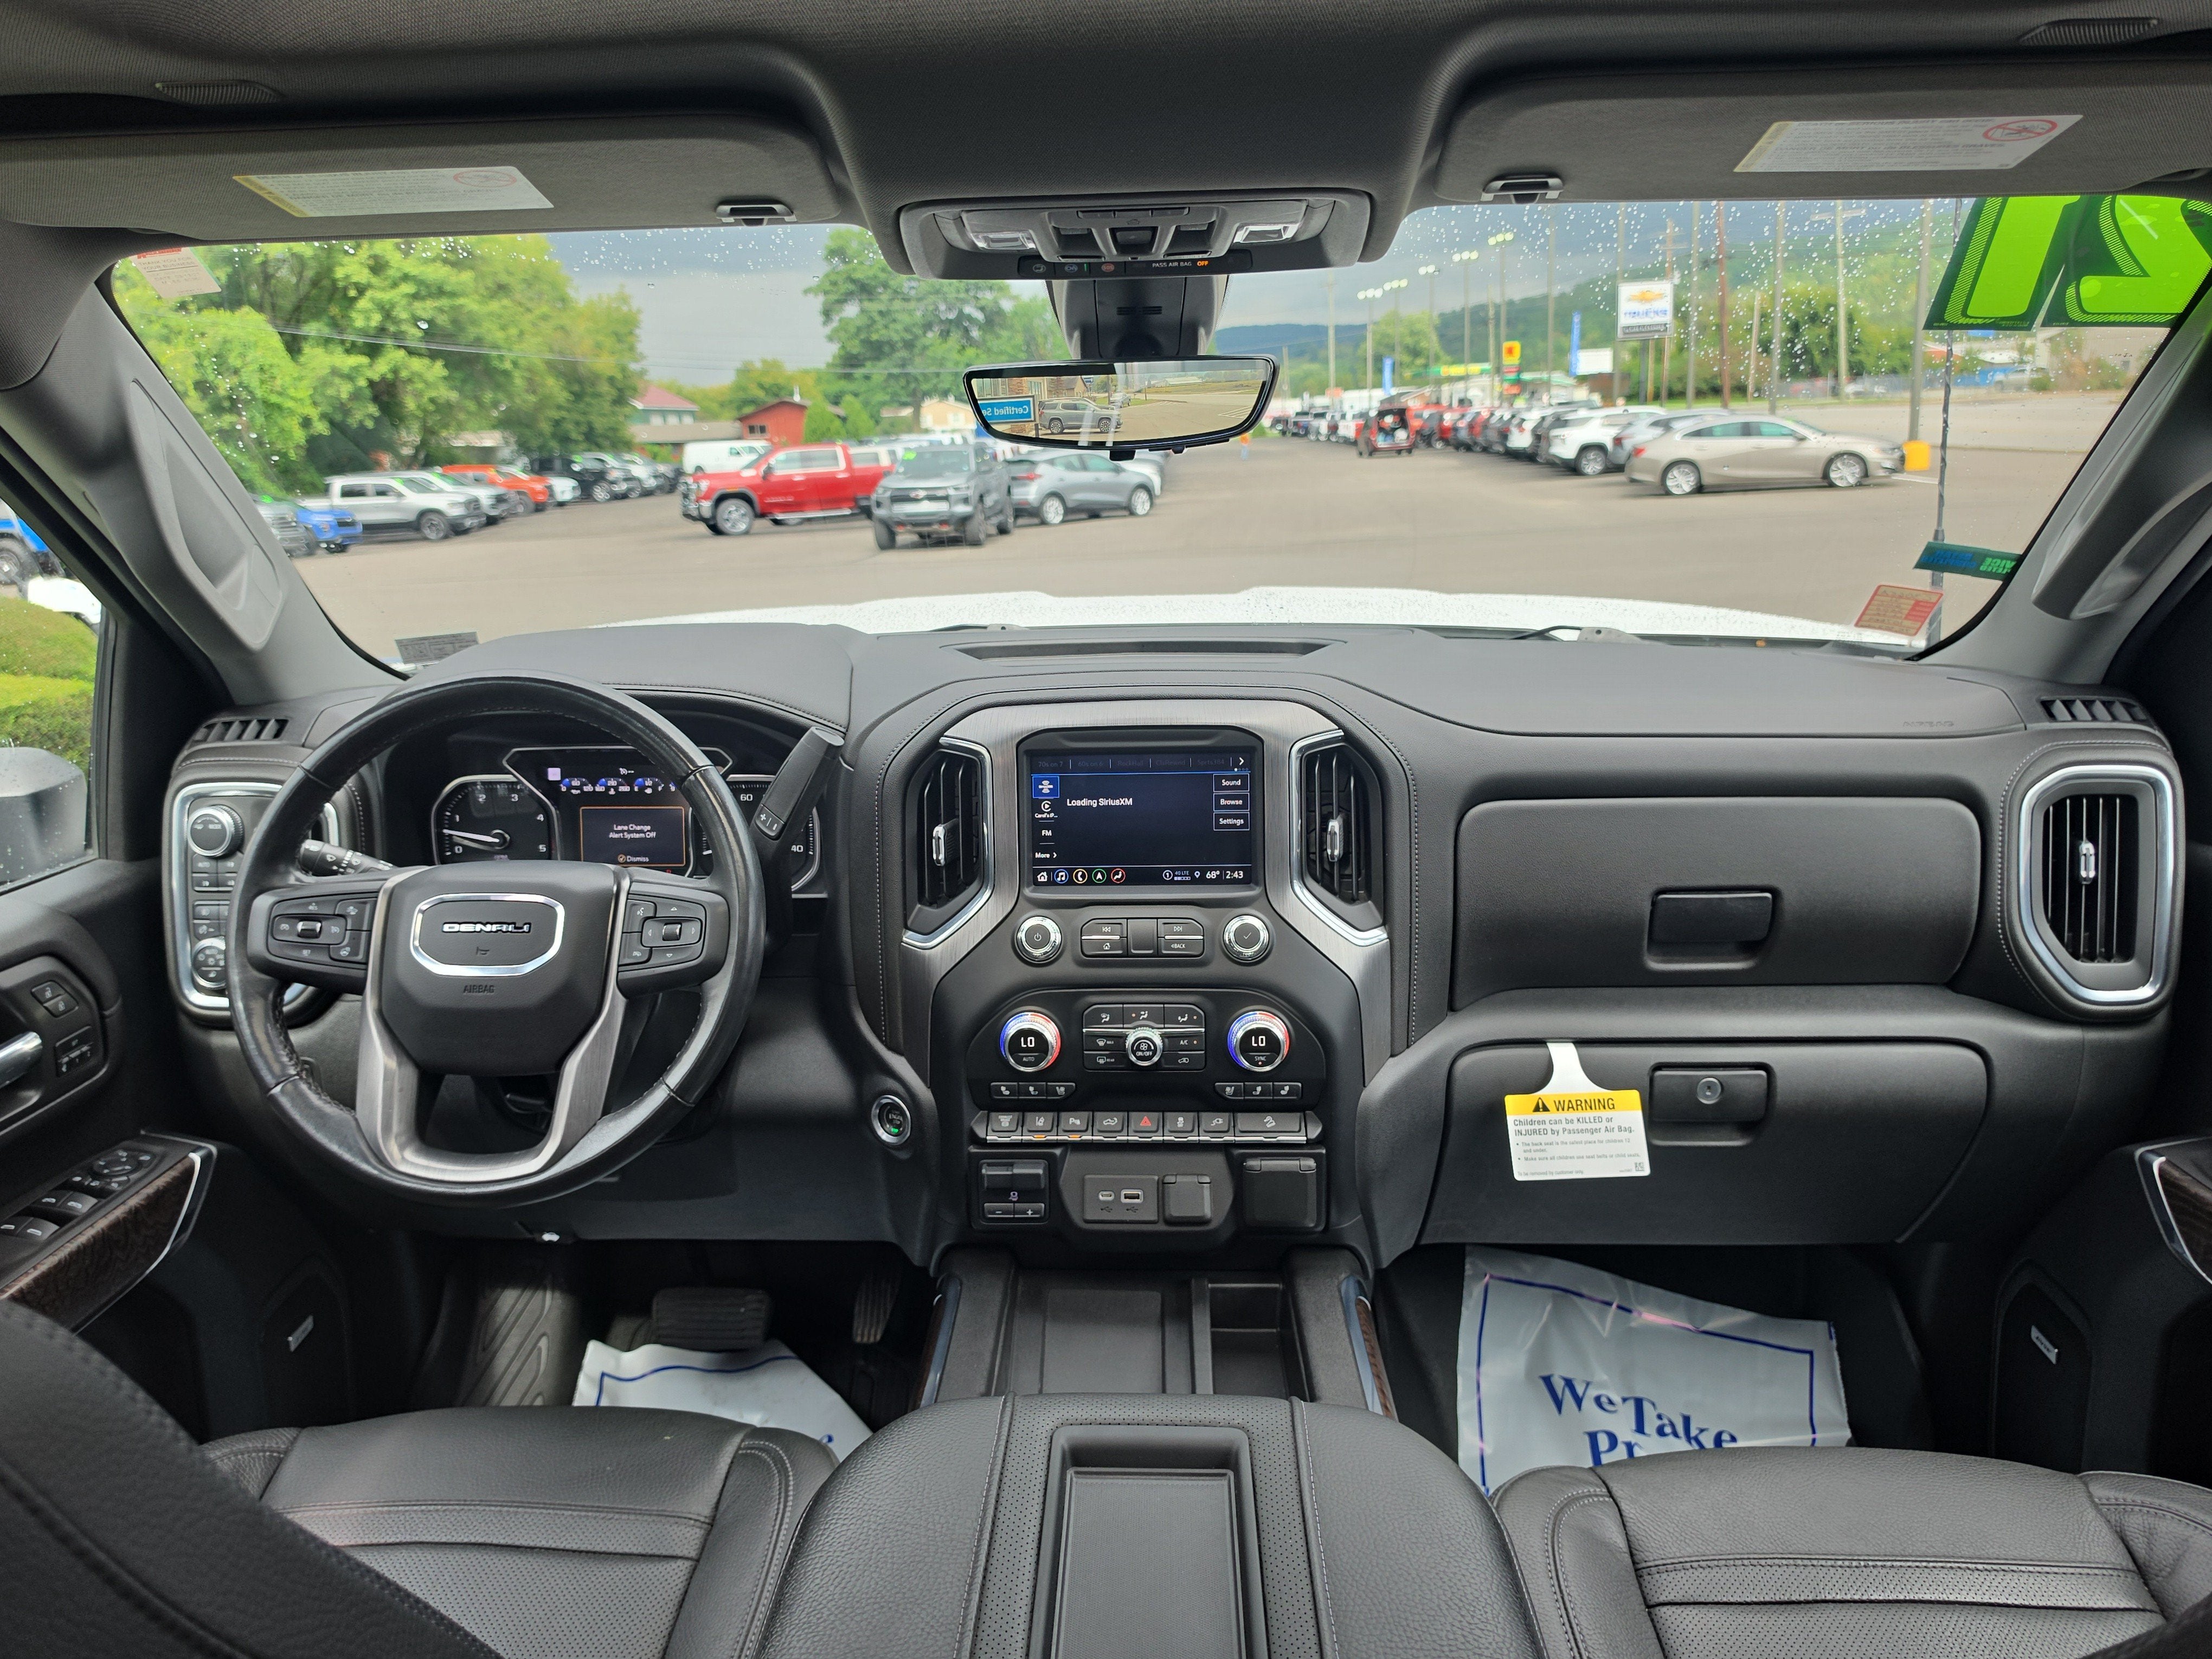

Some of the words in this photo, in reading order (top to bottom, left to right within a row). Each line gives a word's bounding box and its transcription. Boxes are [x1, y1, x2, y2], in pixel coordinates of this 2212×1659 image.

[479, 794, 486, 802] 2
[511, 794, 519, 802] 3
[1067, 799, 1098, 807] Loading
[1098, 798, 1133, 806] SiriusXM
[536, 814, 544, 822] 4
[1219, 818, 1244, 826] Settings
[629, 824, 651, 832] Change
[454, 845, 462, 854] 0
[538, 844, 546, 852] 5
[1226, 871, 1244, 879] 2:43
[442, 922, 531, 933] DENALI
[463, 985, 495, 993] AIRBAG
[1021, 1037, 1035, 1047] LO
[1252, 1036, 1266, 1047] LO
[1554, 1097, 1616, 1112] WARNING
[1513, 1118, 1546, 1127] Children
[1515, 1128, 1548, 1136] INJURED
[1551, 1128, 1560, 1136] by
[1562, 1127, 1601, 1135] Passenger
[1617, 1125, 1635, 1134] Bag.
[1539, 1374, 1619, 1416] We
[1621, 1396, 1738, 1449] Take
